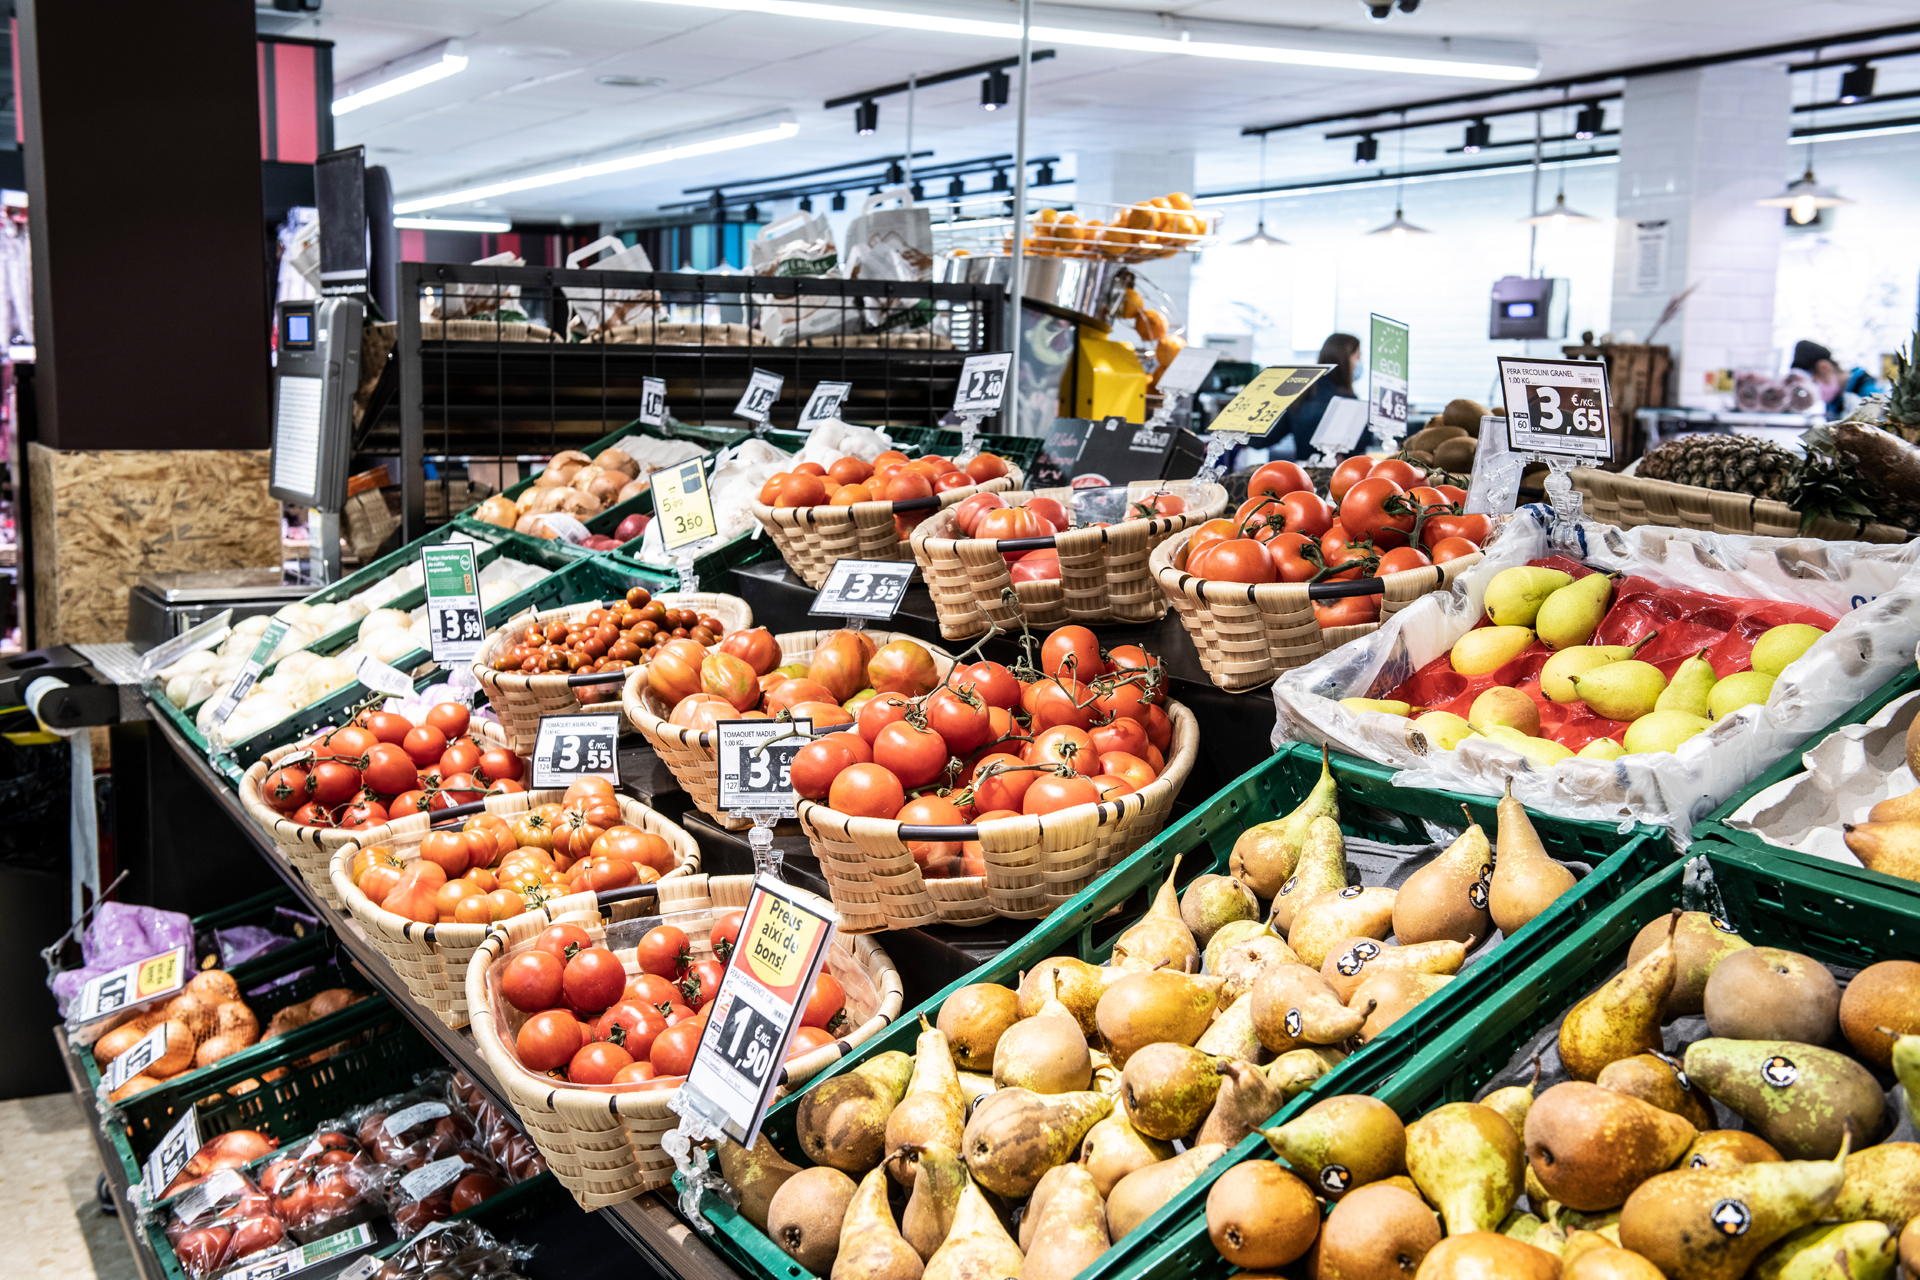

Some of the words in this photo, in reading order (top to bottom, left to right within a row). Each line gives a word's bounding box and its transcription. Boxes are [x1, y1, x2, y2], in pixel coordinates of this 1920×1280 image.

[1380, 357, 1401, 377] eco
[1522, 368, 1549, 376] ERCOLINI
[1550, 369, 1574, 377] GRANEL
[970, 371, 1001, 400] 2,40
[1248, 400, 1278, 423] 3,25
[1517, 420, 1527, 429] 60
[1536, 386, 1602, 434] 3,65
[662, 497, 684, 513] 5,99
[674, 515, 703, 534] 3,50
[846, 573, 901, 602] 3,95
[445, 609, 480, 641] 3,99
[559, 735, 612, 773] 3,55
[748, 747, 791, 792] 3,5
[726, 781, 738, 789] 127
[769, 898, 803, 931] Preus
[762, 921, 786, 944] així
[782, 934, 799, 954] de
[754, 938, 788, 971] bons!
[730, 968, 740, 980] PERA
[740, 975, 765, 998] CONFERENCE
[728, 1005, 771, 1079] 1,90
